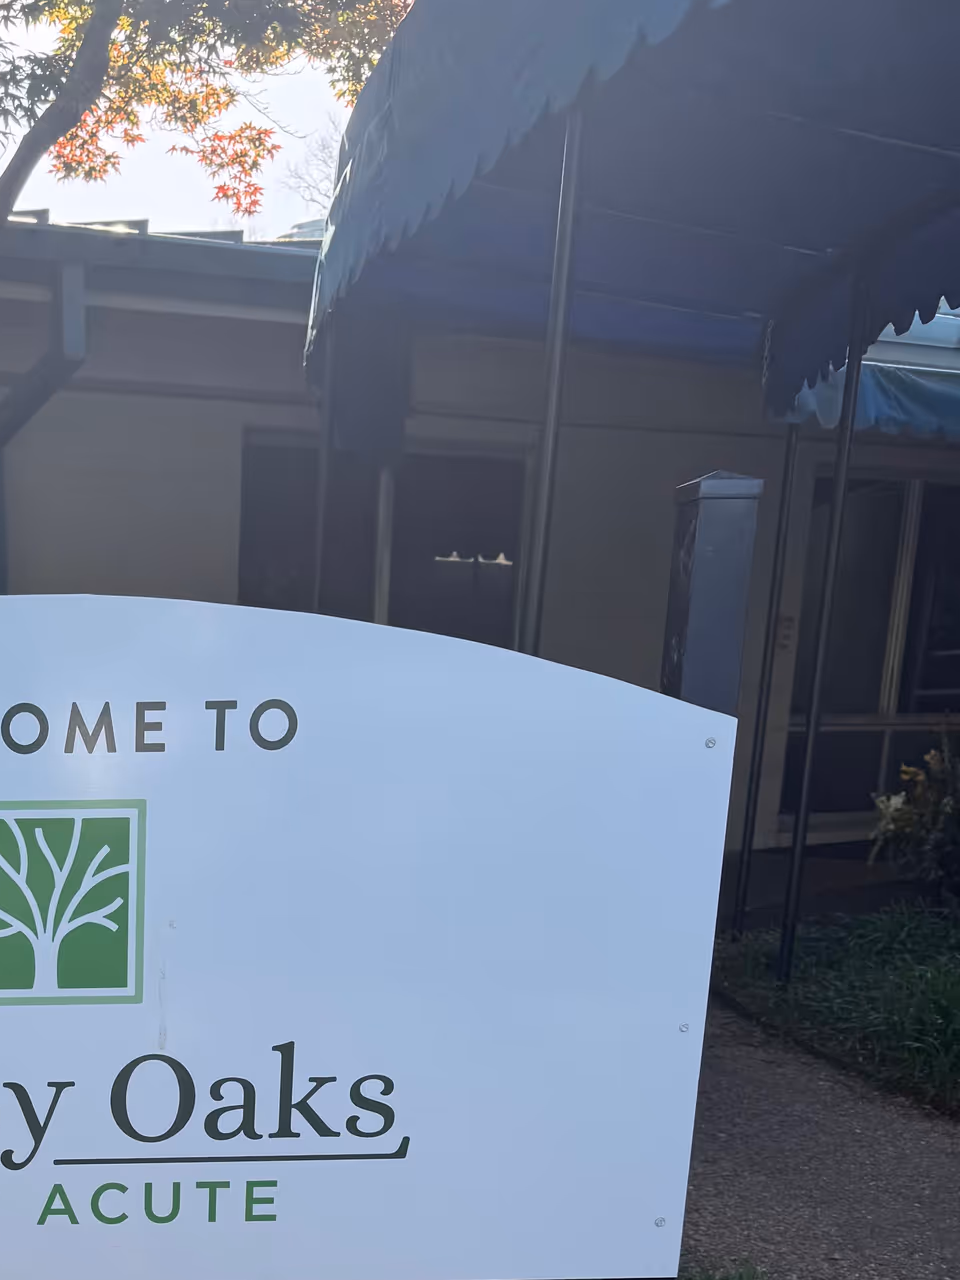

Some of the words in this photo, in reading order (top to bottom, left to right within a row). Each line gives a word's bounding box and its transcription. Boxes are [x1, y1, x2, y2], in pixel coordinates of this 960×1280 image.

[204, 698, 299, 752] TO
[109, 1040, 397, 1147] Oaks
[37, 1180, 278, 1226] ACUTE
